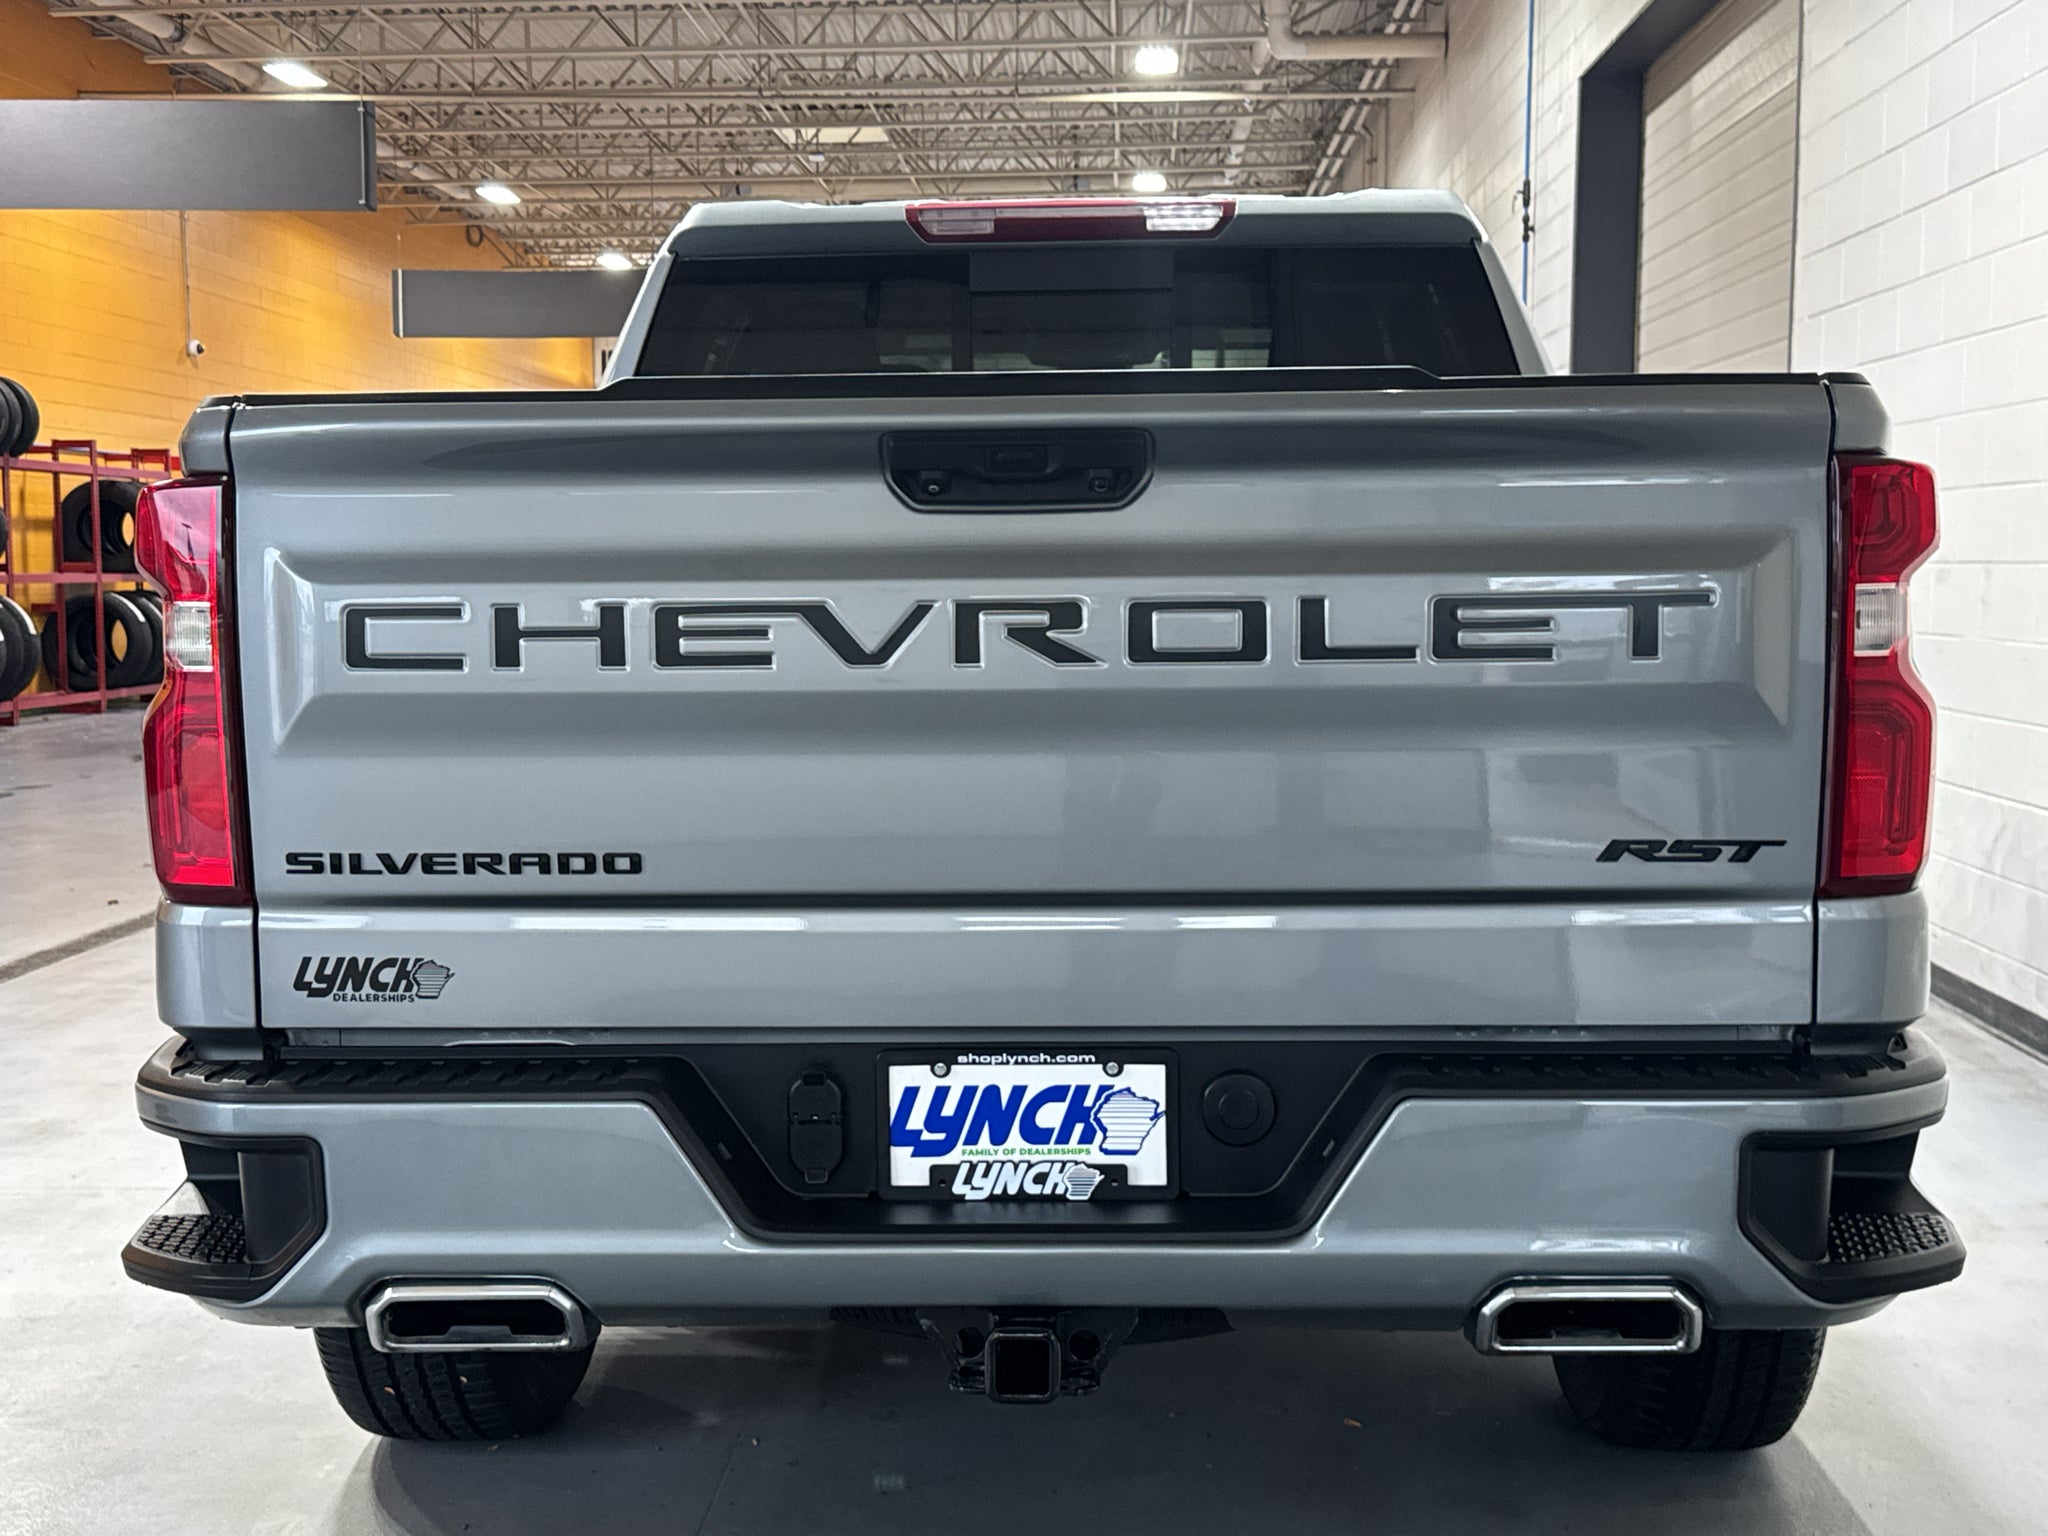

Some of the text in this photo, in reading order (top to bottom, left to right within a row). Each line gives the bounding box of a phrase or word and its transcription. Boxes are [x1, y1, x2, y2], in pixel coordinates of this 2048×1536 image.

[342, 592, 1720, 671] CHEVROLET
[1595, 838, 1788, 863] RST
[285, 852, 643, 875] SILVERADO
[293, 956, 424, 998] LYNCH
[332, 992, 415, 1003] DEALERSHIPS
[957, 1053, 1096, 1065] shoplynch.com
[890, 1084, 1115, 1157] LYNCH
[961, 1148, 1092, 1157] FAMILY OF DEALERSHIPS
[951, 1161, 1076, 1201] LYNCH
